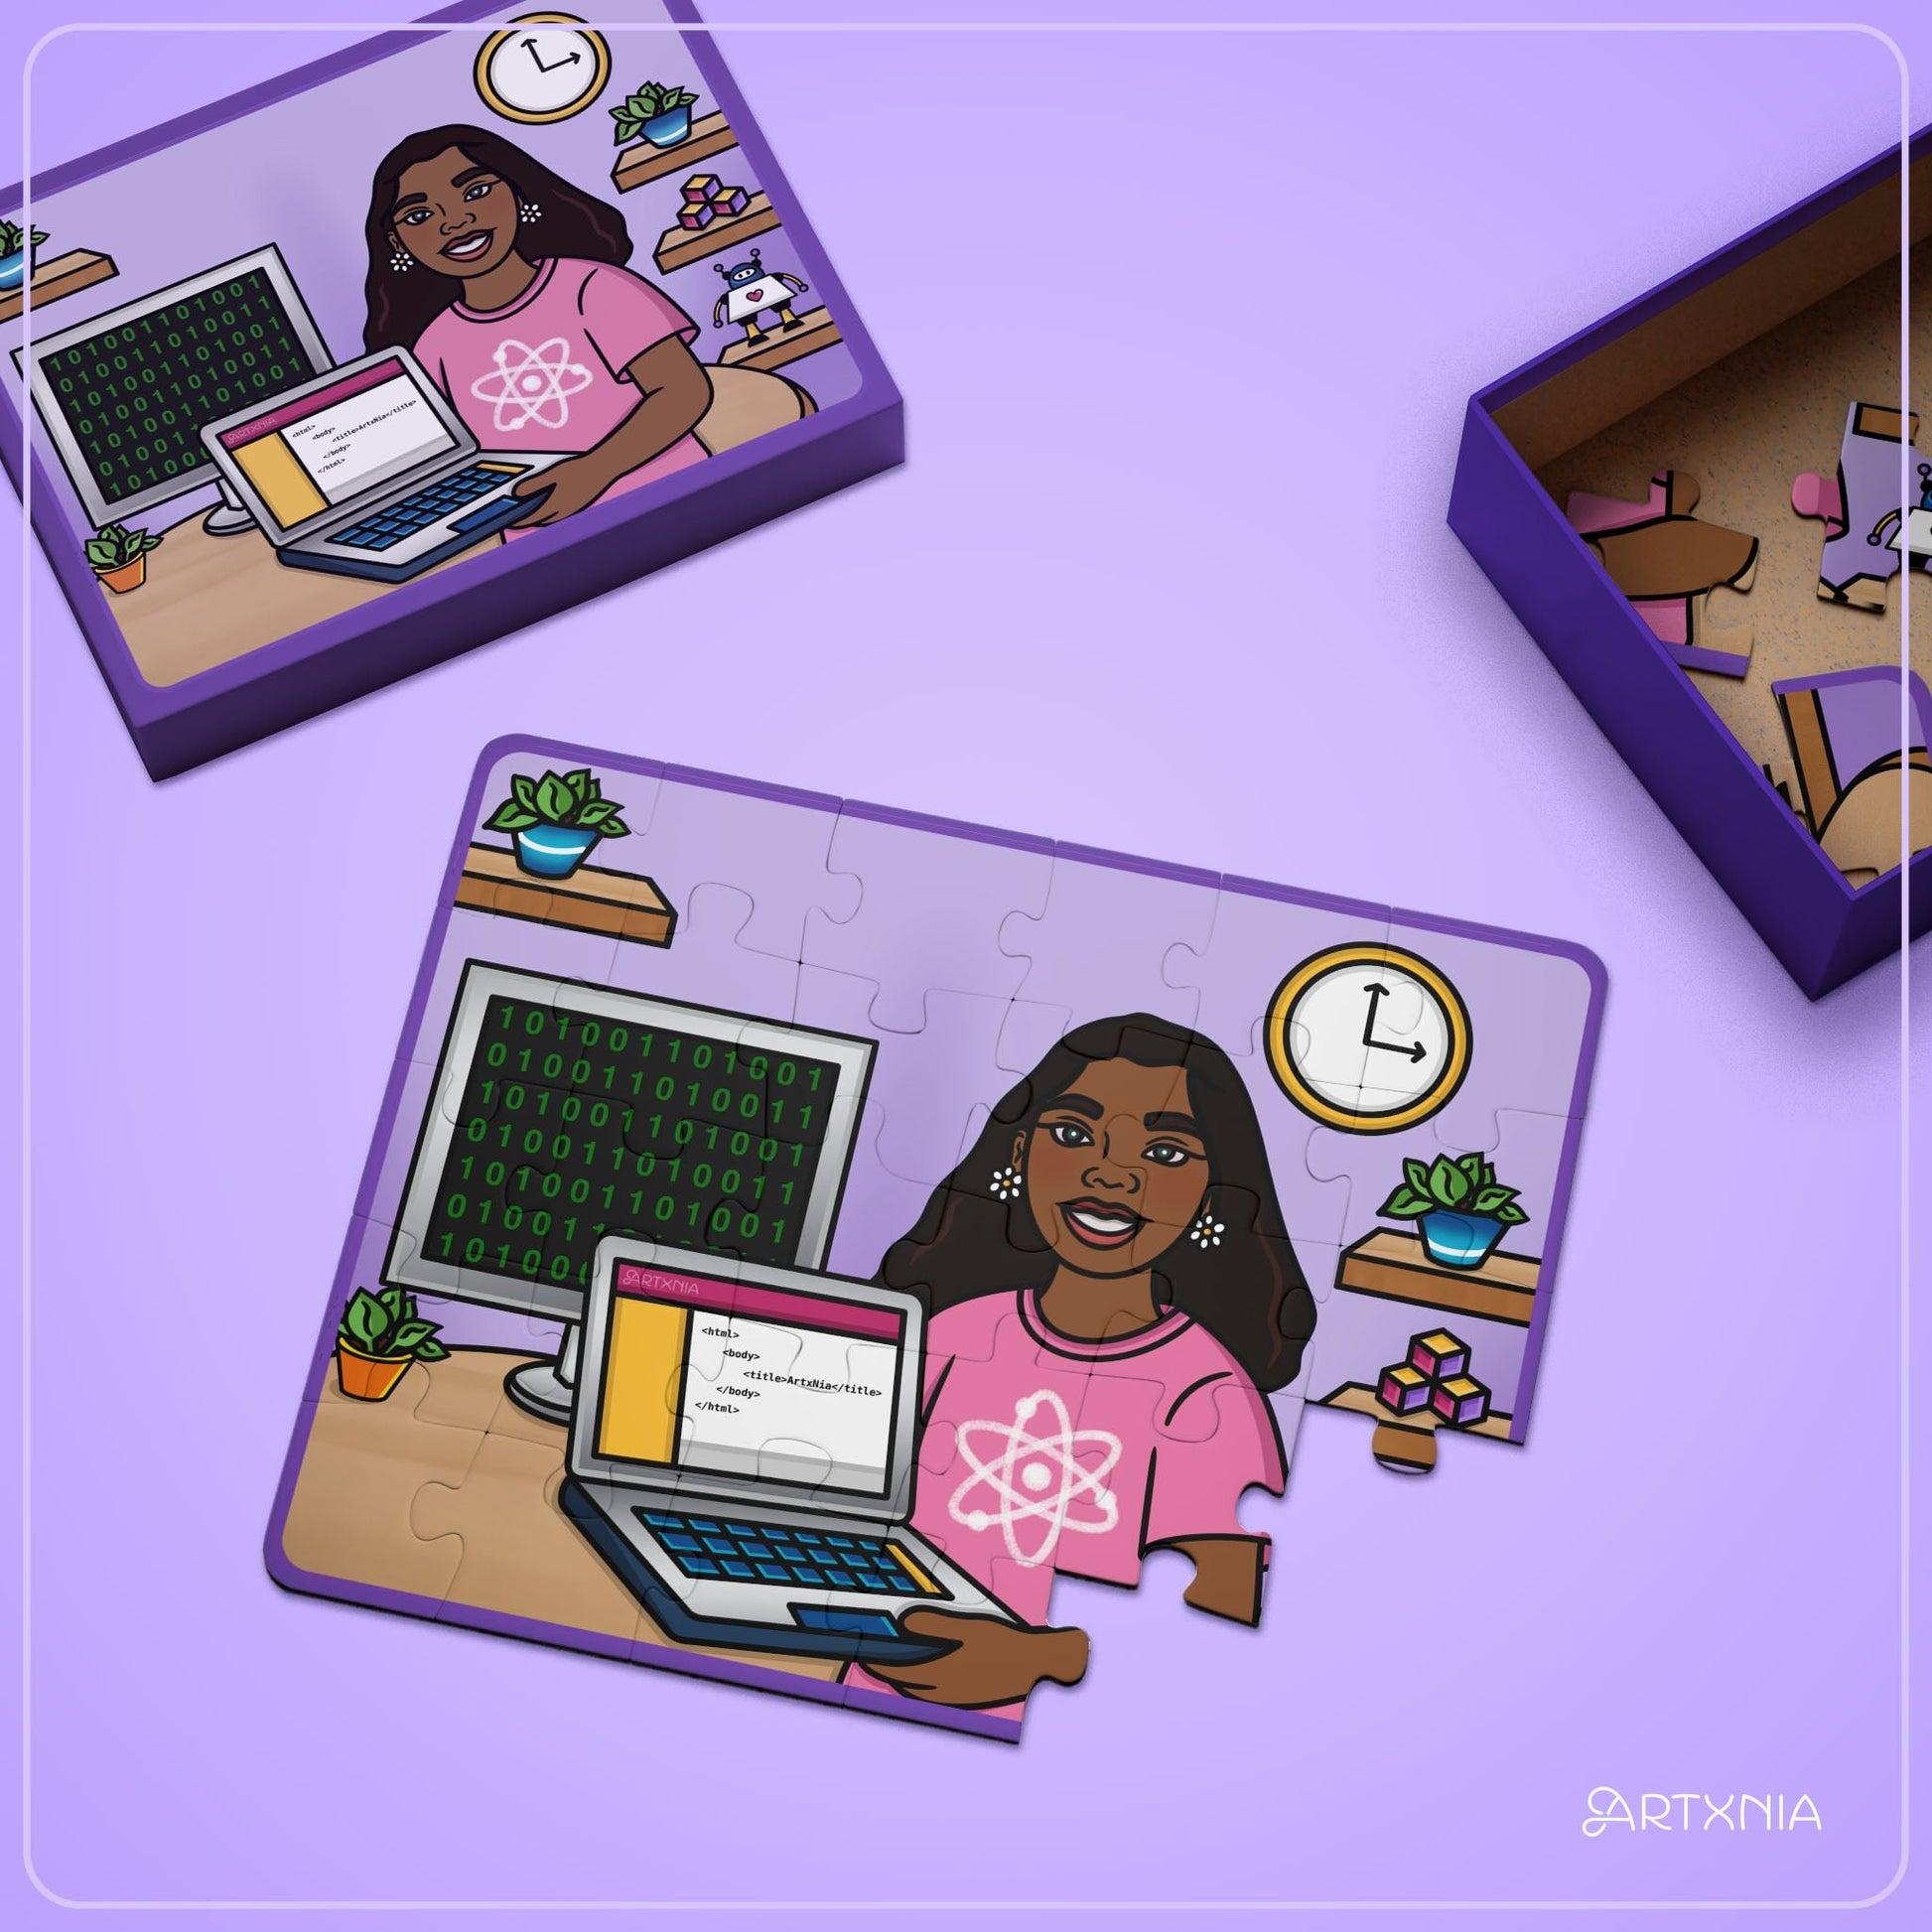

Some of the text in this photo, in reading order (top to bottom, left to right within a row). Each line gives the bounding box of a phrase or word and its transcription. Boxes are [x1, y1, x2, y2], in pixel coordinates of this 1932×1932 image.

[622, 1269, 700, 1296] ARTXNIA
[701, 1326, 740, 1339] <html>
[722, 1347, 760, 1362] <body>
[716, 1384, 760, 1400] </body>
[694, 1401, 740, 1415] </html>
